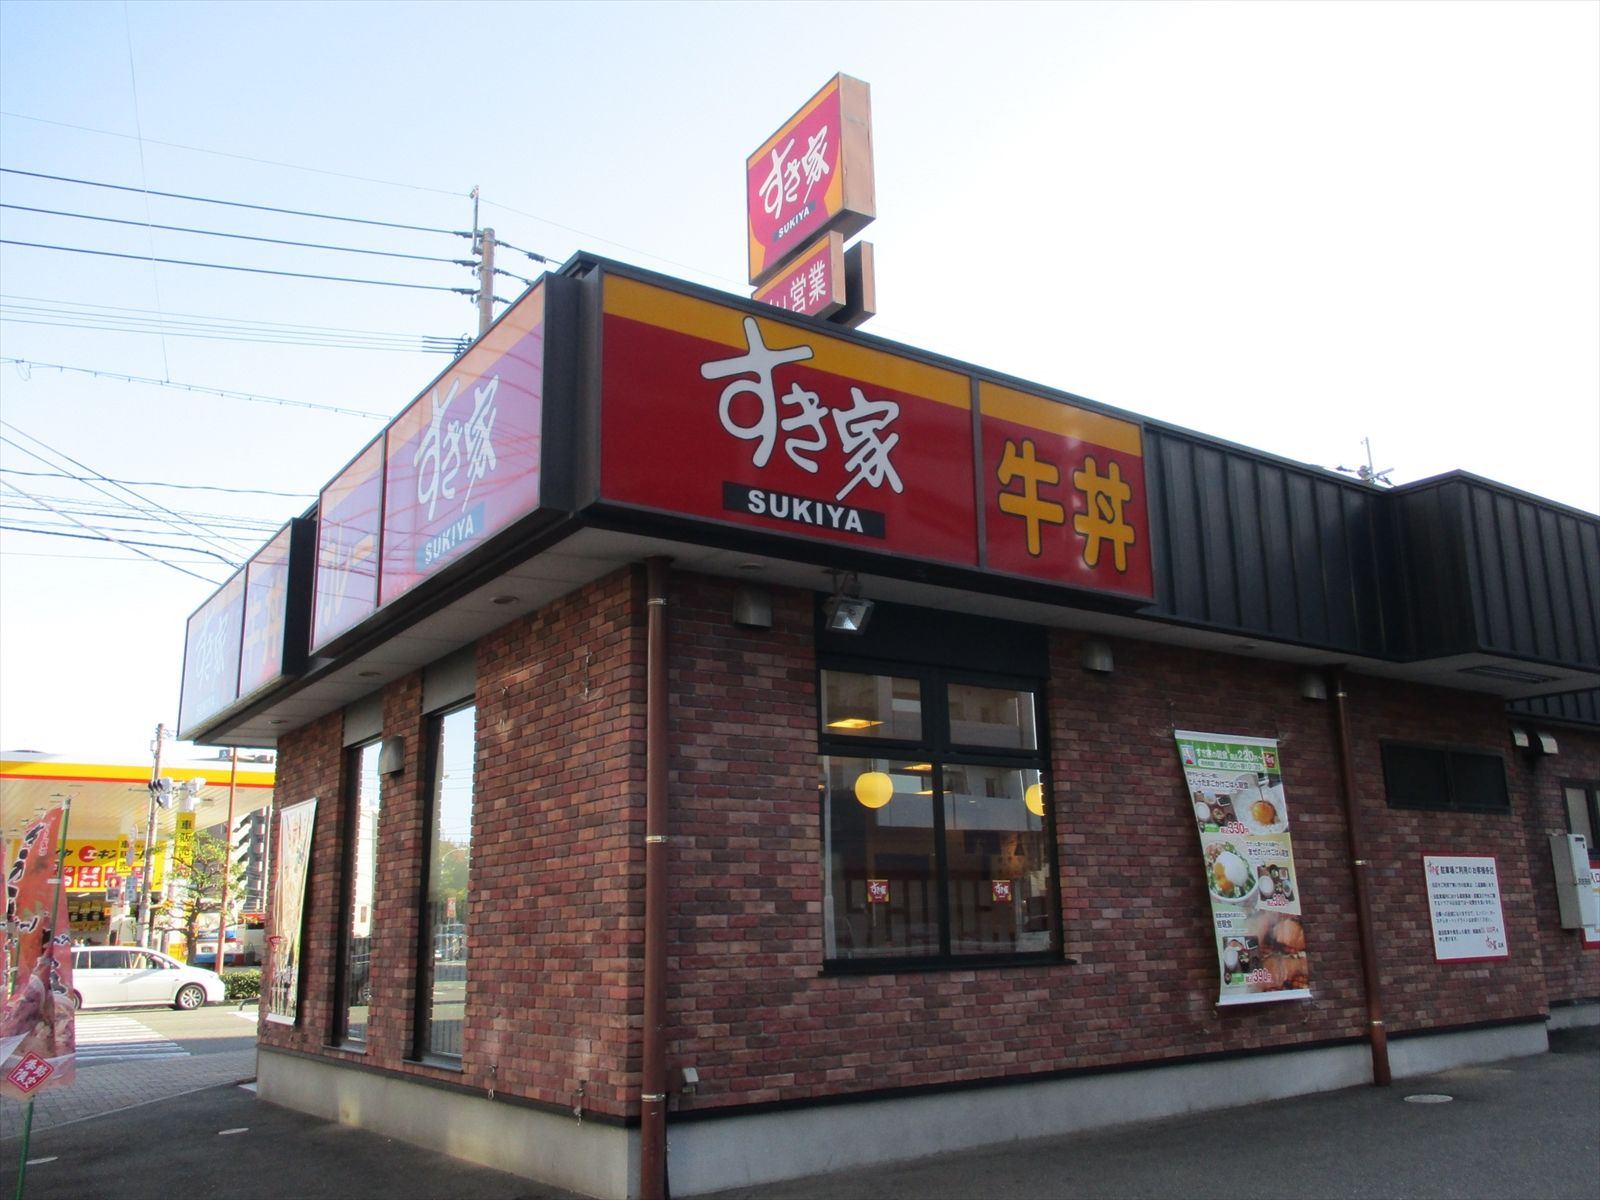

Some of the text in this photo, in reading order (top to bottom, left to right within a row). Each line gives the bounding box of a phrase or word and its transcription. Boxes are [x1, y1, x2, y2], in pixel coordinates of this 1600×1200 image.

[759, 125, 830, 220] すき家
[778, 209, 810, 238] SUKIYA
[414, 374, 499, 521] すき家
[701, 316, 904, 501] すき家
[424, 513, 474, 566] SUKIYA
[747, 489, 864, 534] SUKIYA
[997, 438, 1136, 572] 牛丼
